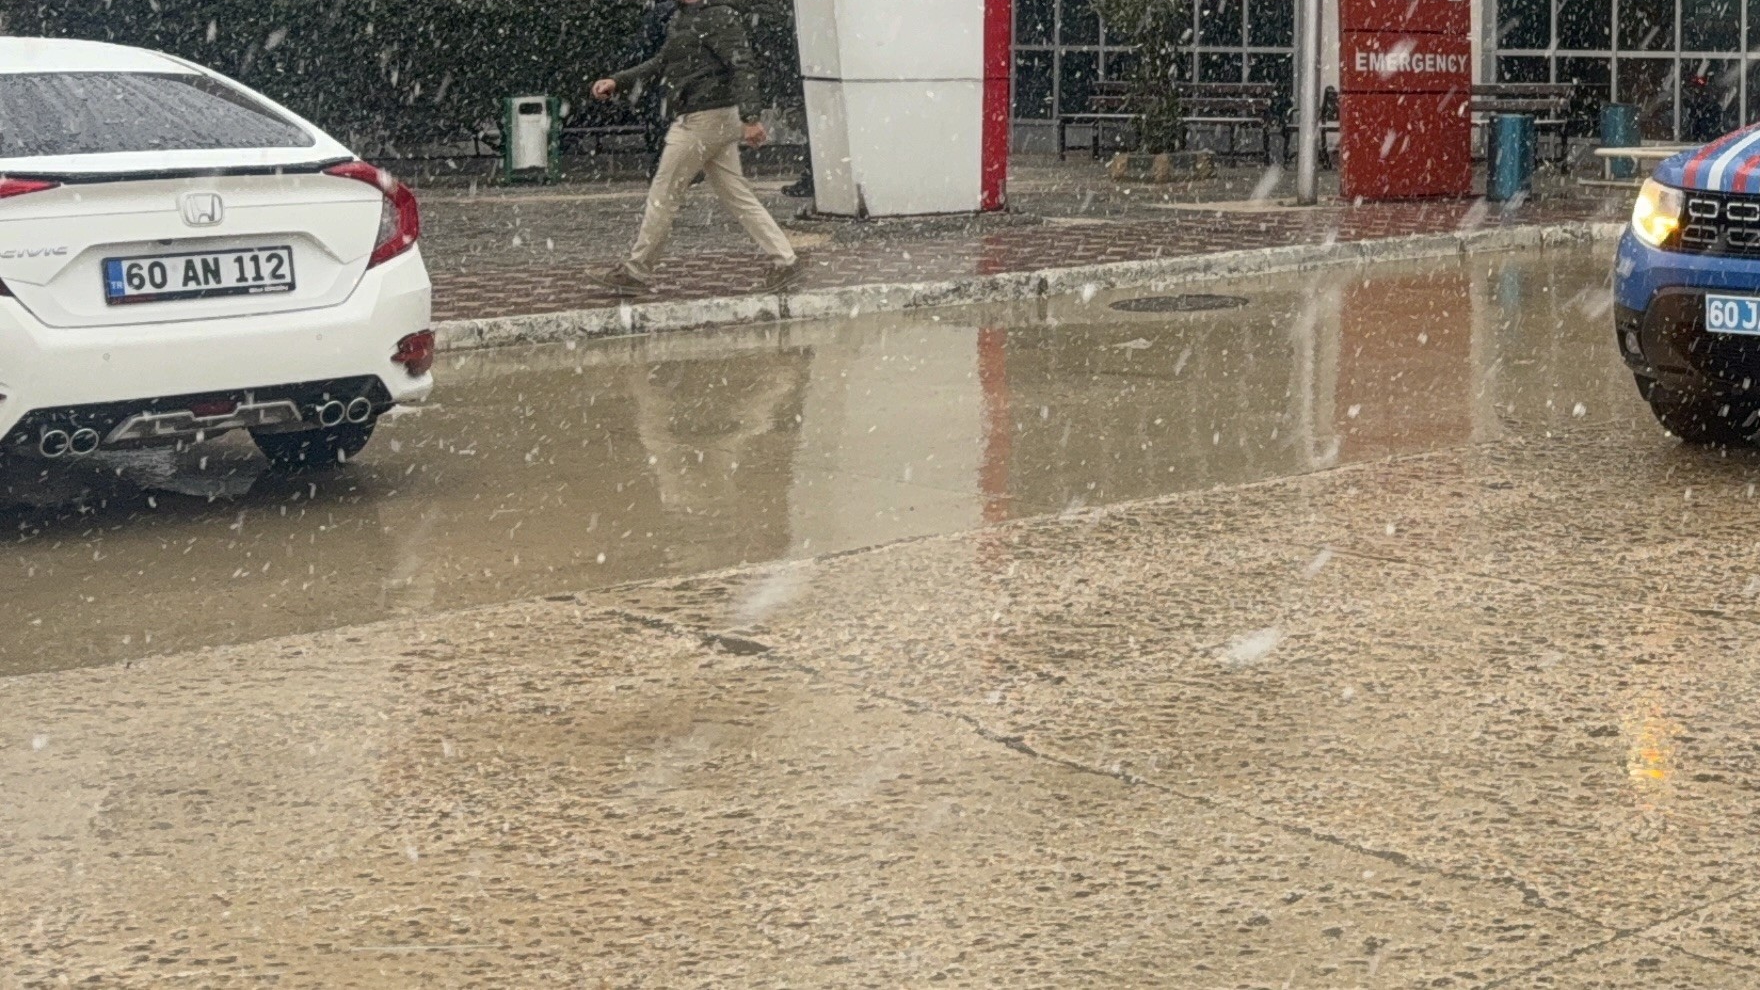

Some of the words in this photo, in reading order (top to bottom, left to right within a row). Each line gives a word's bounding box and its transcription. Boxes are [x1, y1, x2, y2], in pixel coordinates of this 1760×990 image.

[1355, 51, 1468, 73] EMERGENCY
[126, 262, 168, 291] 60
[181, 257, 222, 288] AN
[233, 252, 287, 284] 112
[1710, 300, 1739, 328] 60
